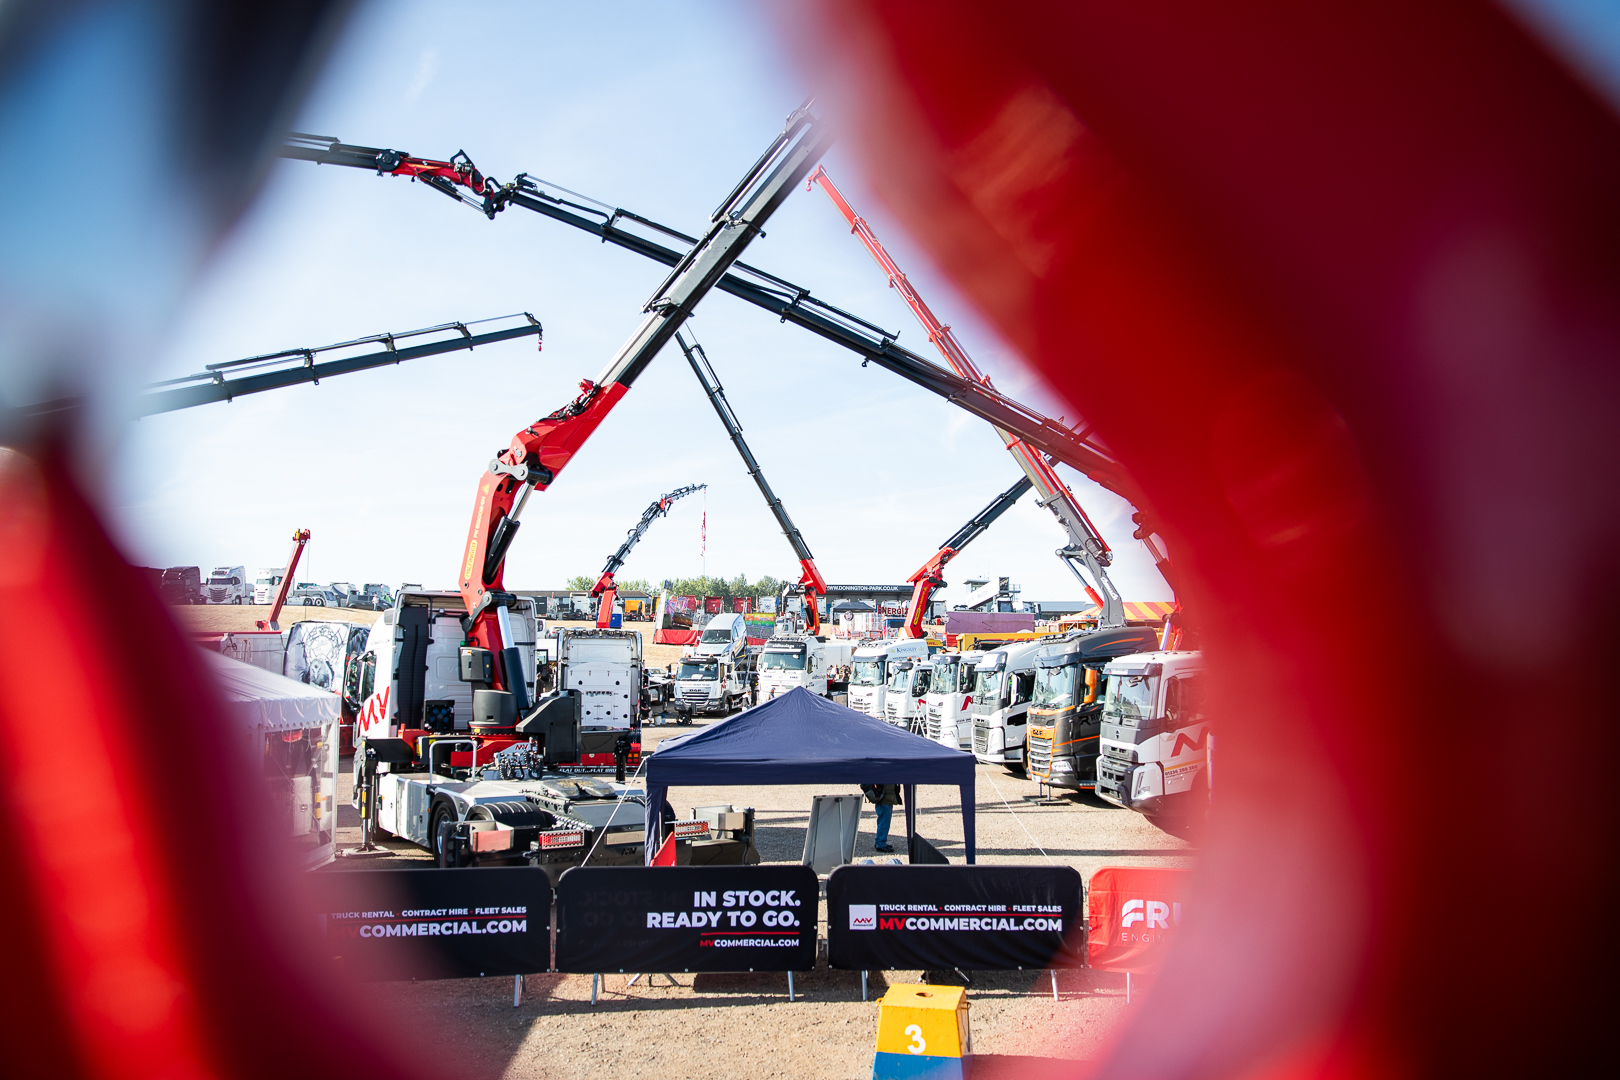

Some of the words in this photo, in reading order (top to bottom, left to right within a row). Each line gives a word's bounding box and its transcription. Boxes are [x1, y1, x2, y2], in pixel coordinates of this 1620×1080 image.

[358, 686, 390, 732] MV
[694, 891, 716, 907] IN
[722, 890, 800, 907] STOCK.
[332, 912, 360, 920] TRUCK
[402, 909, 447, 917] CONTRACT
[647, 911, 722, 928] READY
[727, 911, 756, 927] TO
[762, 910, 800, 927] GO.
[880, 918, 1062, 932] MVCOMMERCIAL.COM
[700, 939, 799, 947] MVCOMMERCIAL.COM
[905, 1024, 926, 1054] 3
